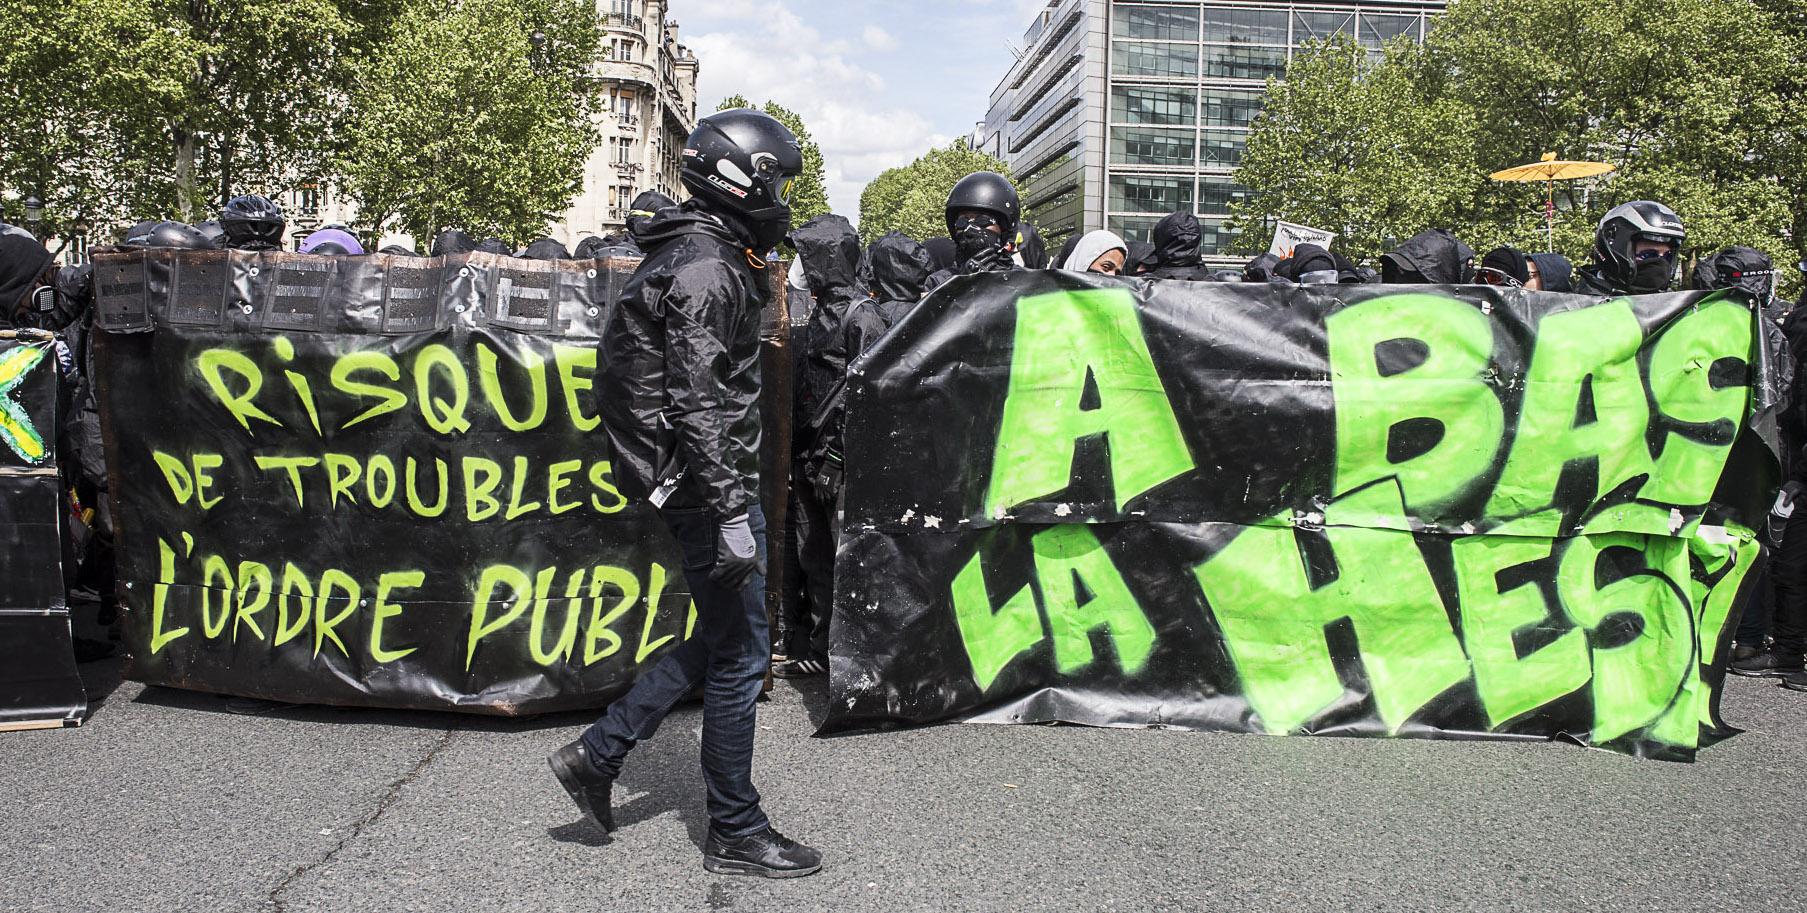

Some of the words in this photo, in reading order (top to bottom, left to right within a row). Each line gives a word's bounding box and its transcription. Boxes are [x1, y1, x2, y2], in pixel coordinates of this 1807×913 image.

[984, 288, 1196, 517] A
[1323, 293, 1755, 524] BAS
[152, 450, 224, 511] DE
[254, 452, 628, 522] TROUBLES
[150, 531, 427, 664] L'ORDRE
[951, 520, 1158, 691] LA
